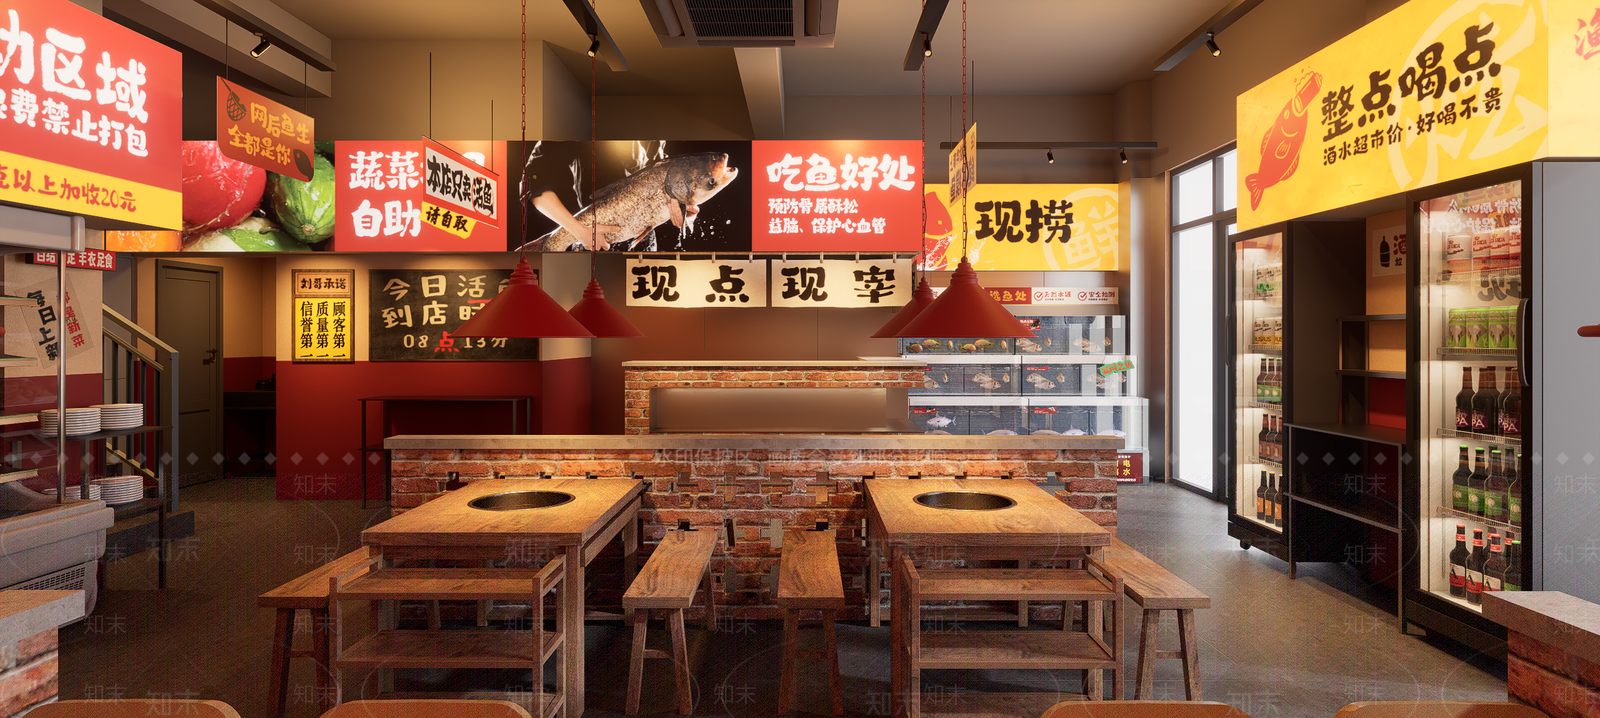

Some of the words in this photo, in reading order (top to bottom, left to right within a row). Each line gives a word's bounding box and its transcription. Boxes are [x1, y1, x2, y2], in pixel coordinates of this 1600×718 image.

[1321, 22, 1502, 142] 整点喝点
[250, 102, 310, 144] 网后鱼生
[228, 124, 291, 165] 全都是你
[349, 150, 424, 190] 蔬菜
[427, 155, 494, 215] 本店只卖活鱼
[766, 153, 916, 192] 吃鱼好处
[351, 199, 421, 237] 自助
[426, 206, 468, 232] 请自取
[768, 198, 858, 215] 预防骨质酥松
[768, 217, 886, 234] 益脑、保护心血管
[974, 199, 1074, 243] 现捞
[37, 252, 76, 264] 自给足
[78, 251, 113, 269] 丰衣足食
[300, 278, 346, 289] 刘哥承诺
[631, 265, 749, 302] 现点
[781, 265, 896, 303] 现宰
[300, 301, 313, 357] 信誉第一
[316, 301, 329, 357] 质量第一
[333, 301, 346, 357] 顾客第一
